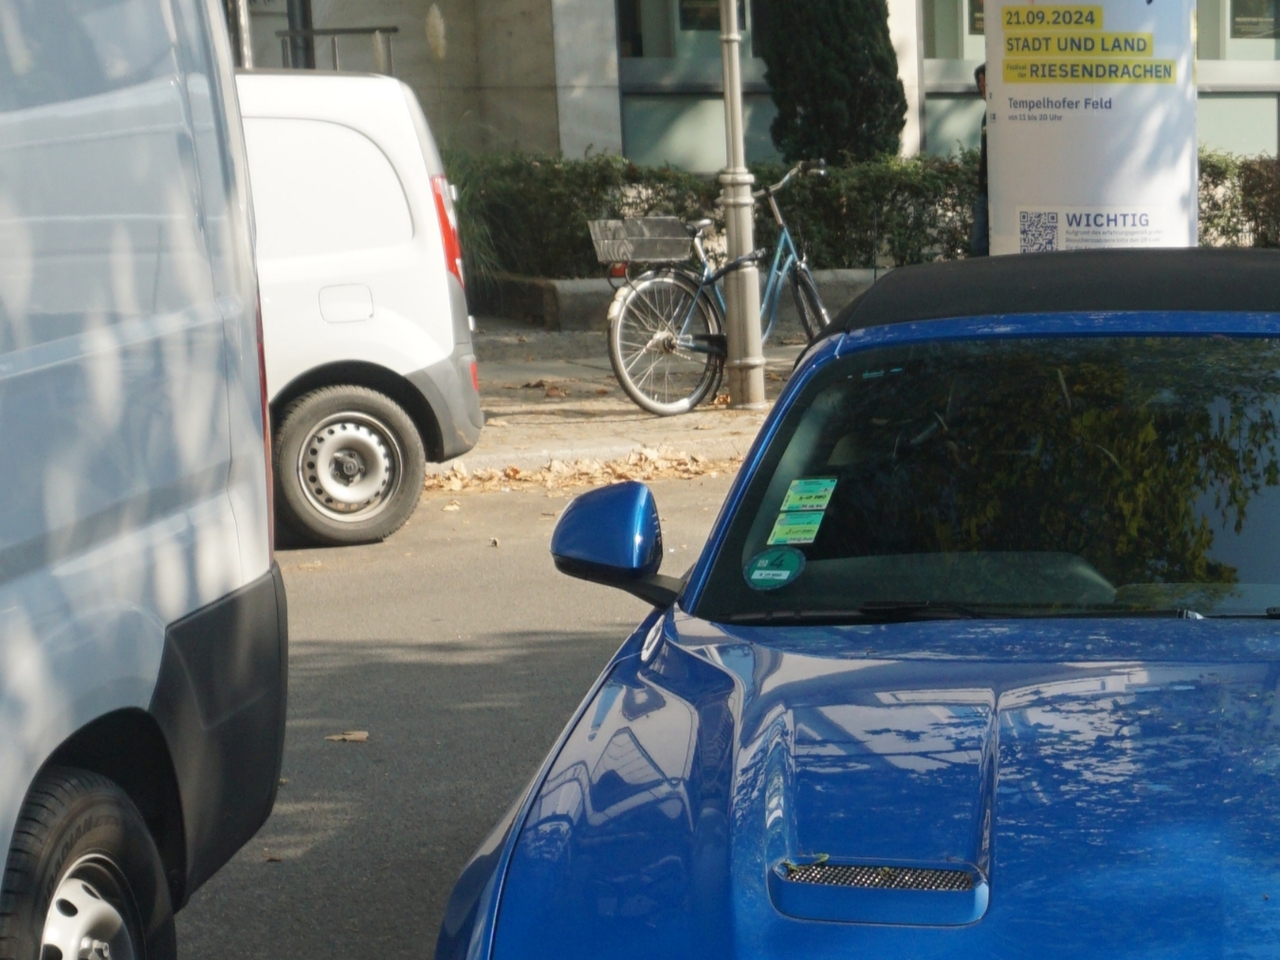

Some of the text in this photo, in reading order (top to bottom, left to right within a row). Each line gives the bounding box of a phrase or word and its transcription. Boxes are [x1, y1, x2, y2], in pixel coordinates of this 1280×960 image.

[1006, 11, 1095, 25] 21.09.2024
[1006, 37, 1147, 52] STADT UND LAND
[1029, 64, 1172, 79] RIESENDRACHEN
[1008, 97, 1112, 112] Tempelhofer Feld
[1027, 113, 1037, 121] bis
[1049, 113, 1063, 121] Uhr
[1066, 213, 1149, 228] WICHTIG
[769, 552, 785, 568] 4
